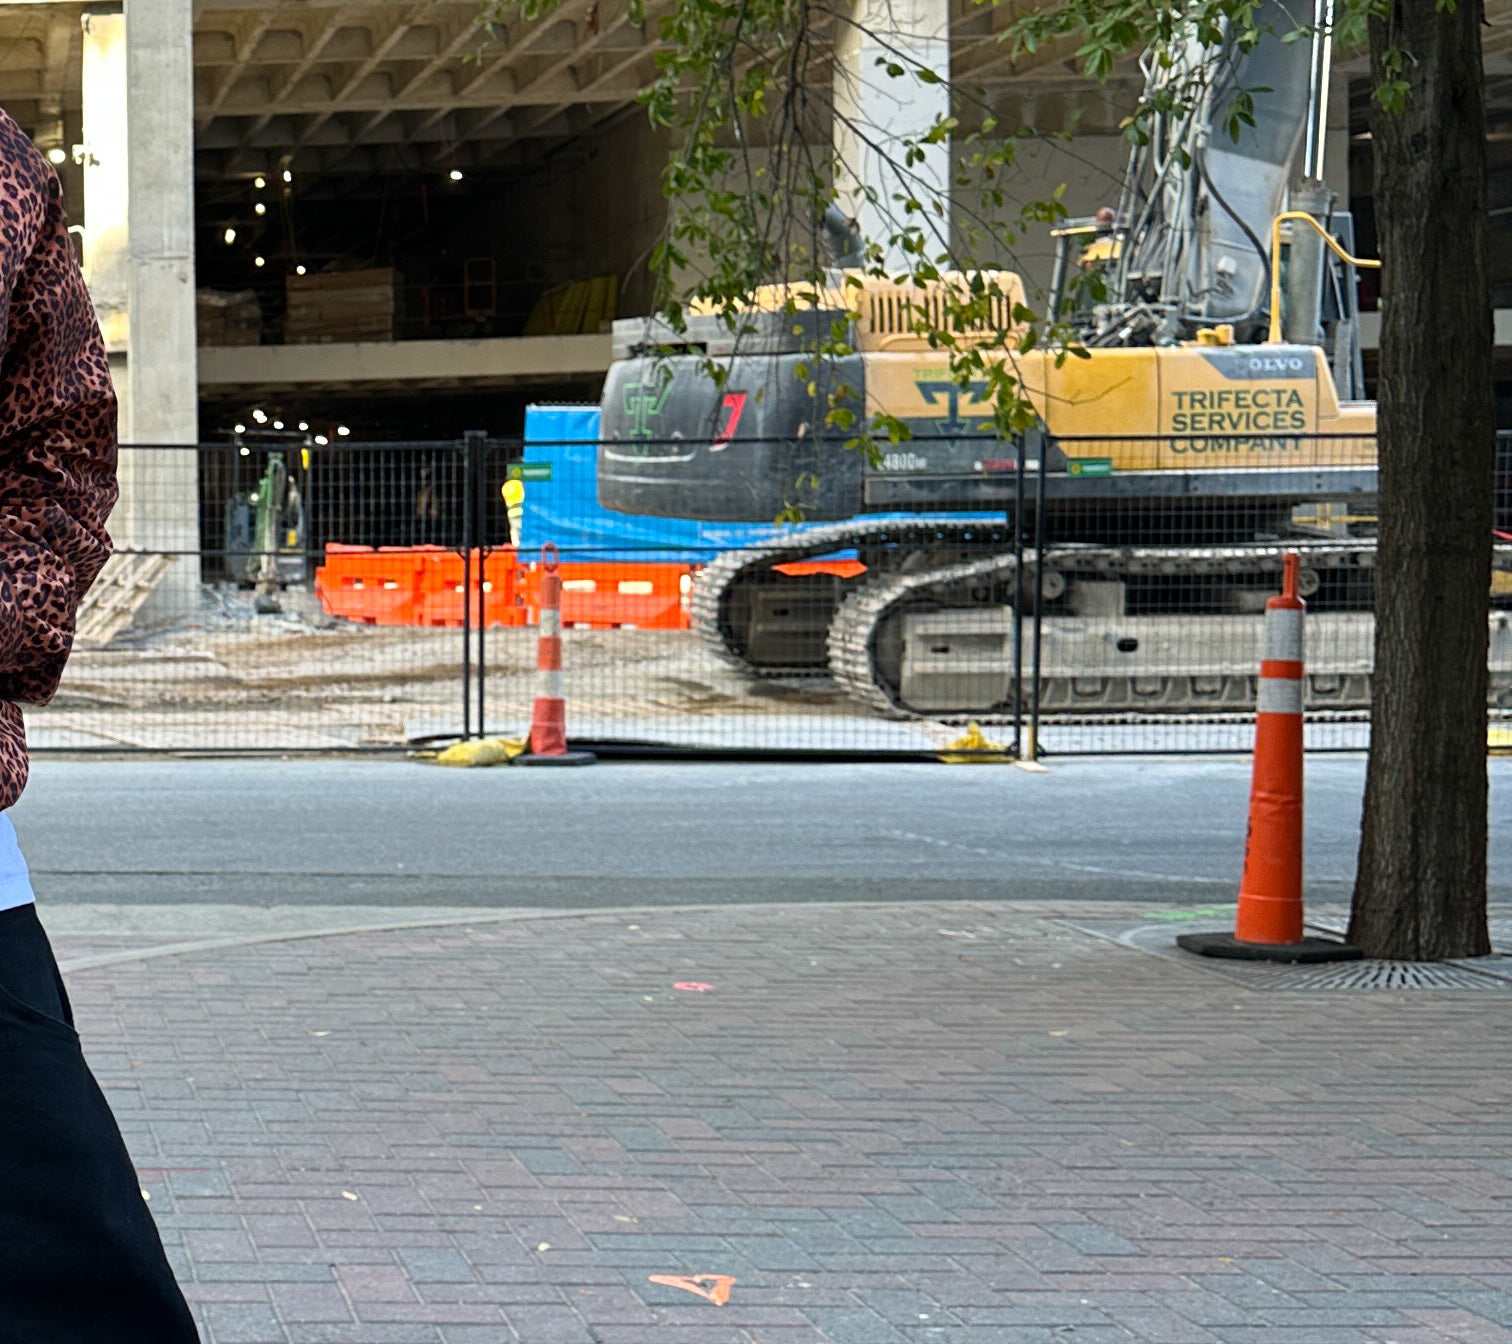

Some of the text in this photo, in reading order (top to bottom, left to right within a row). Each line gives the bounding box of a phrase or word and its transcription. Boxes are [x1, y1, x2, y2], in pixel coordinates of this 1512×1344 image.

[1171, 389, 1304, 410] TRIFECTA
[1172, 410, 1305, 432] SERVICES
[1170, 434, 1302, 454] COMPANY
